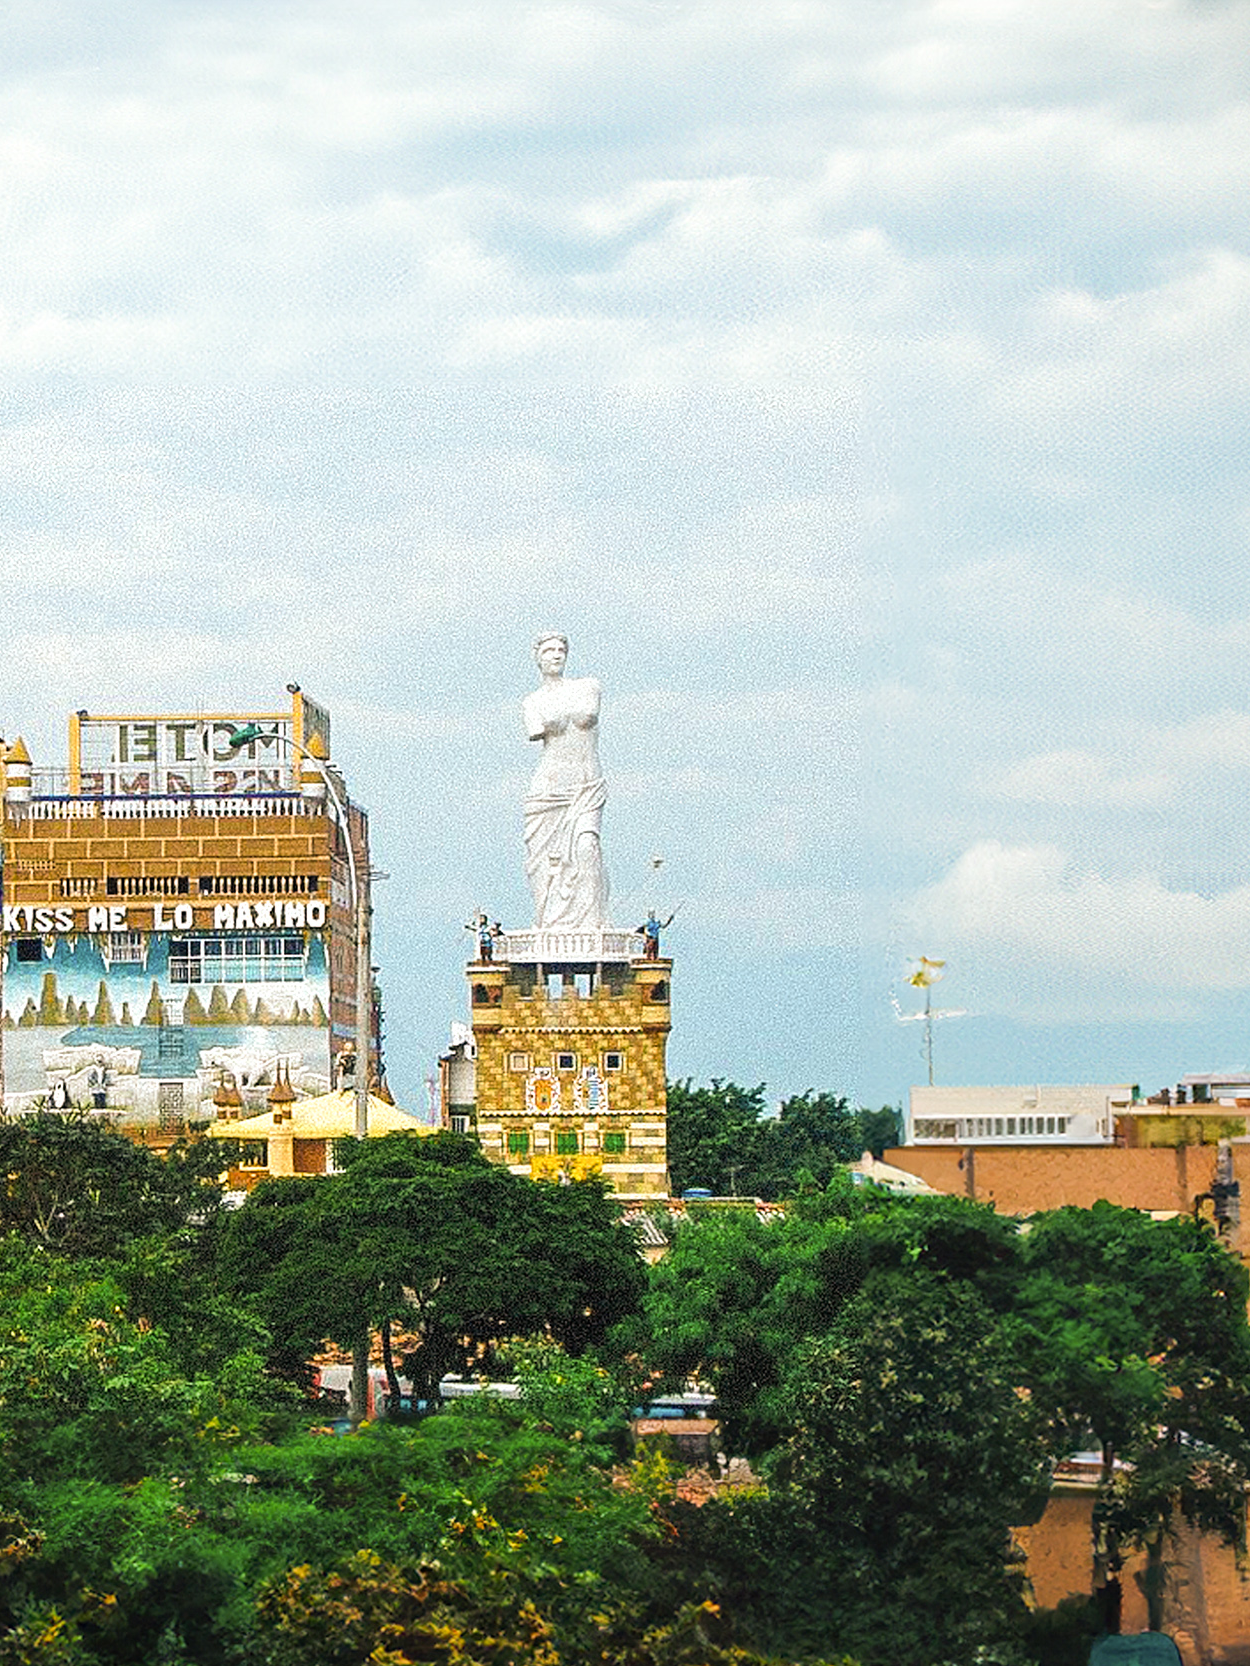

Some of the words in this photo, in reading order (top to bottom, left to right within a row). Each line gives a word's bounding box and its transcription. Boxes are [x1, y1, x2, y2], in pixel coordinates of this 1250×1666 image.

[2, 905, 74, 932] KISS
[88, 905, 128, 932] ME
[154, 902, 193, 930] LO
[214, 900, 326, 929] MAXIMO
